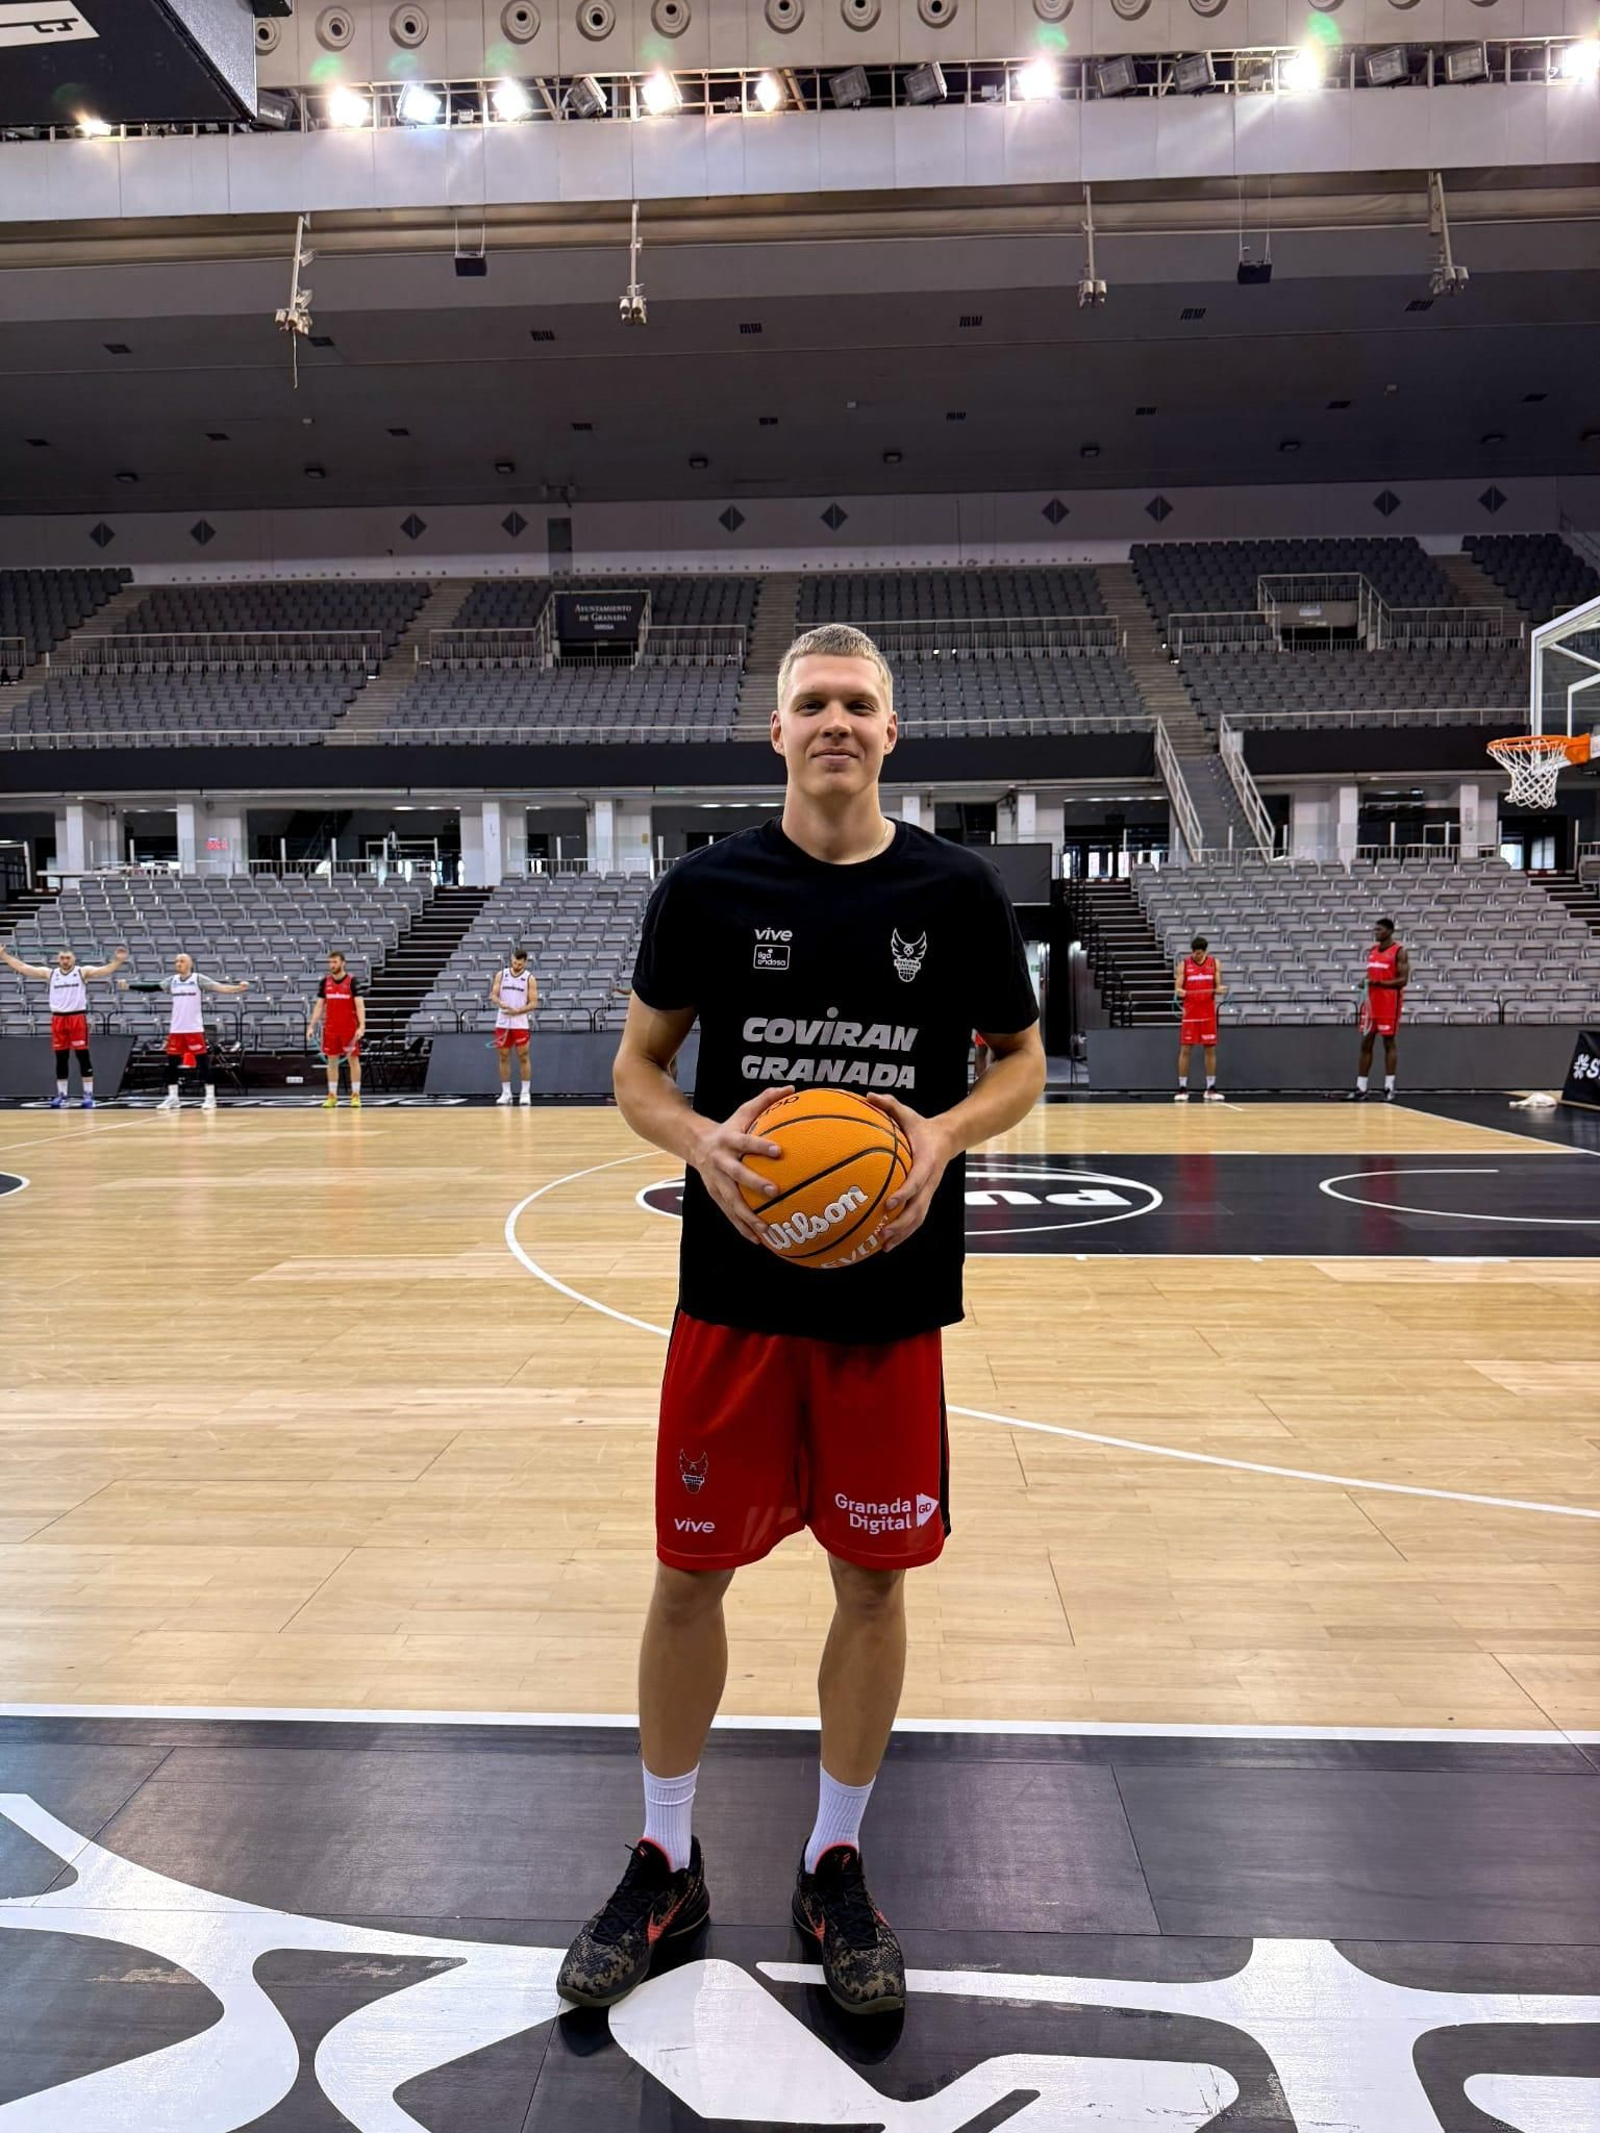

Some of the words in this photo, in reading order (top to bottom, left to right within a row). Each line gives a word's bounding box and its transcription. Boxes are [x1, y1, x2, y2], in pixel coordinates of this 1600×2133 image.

[754, 927, 793, 942] vive
[741, 1055, 916, 1089] GRANADA
[1573, 1053, 1600, 1080] #S
[763, 1185, 869, 1250] Wilson
[834, 1493, 912, 1515] Granada
[918, 1502, 932, 1514] GD
[673, 1517, 716, 1533] vive
[849, 1512, 912, 1535] Digital
